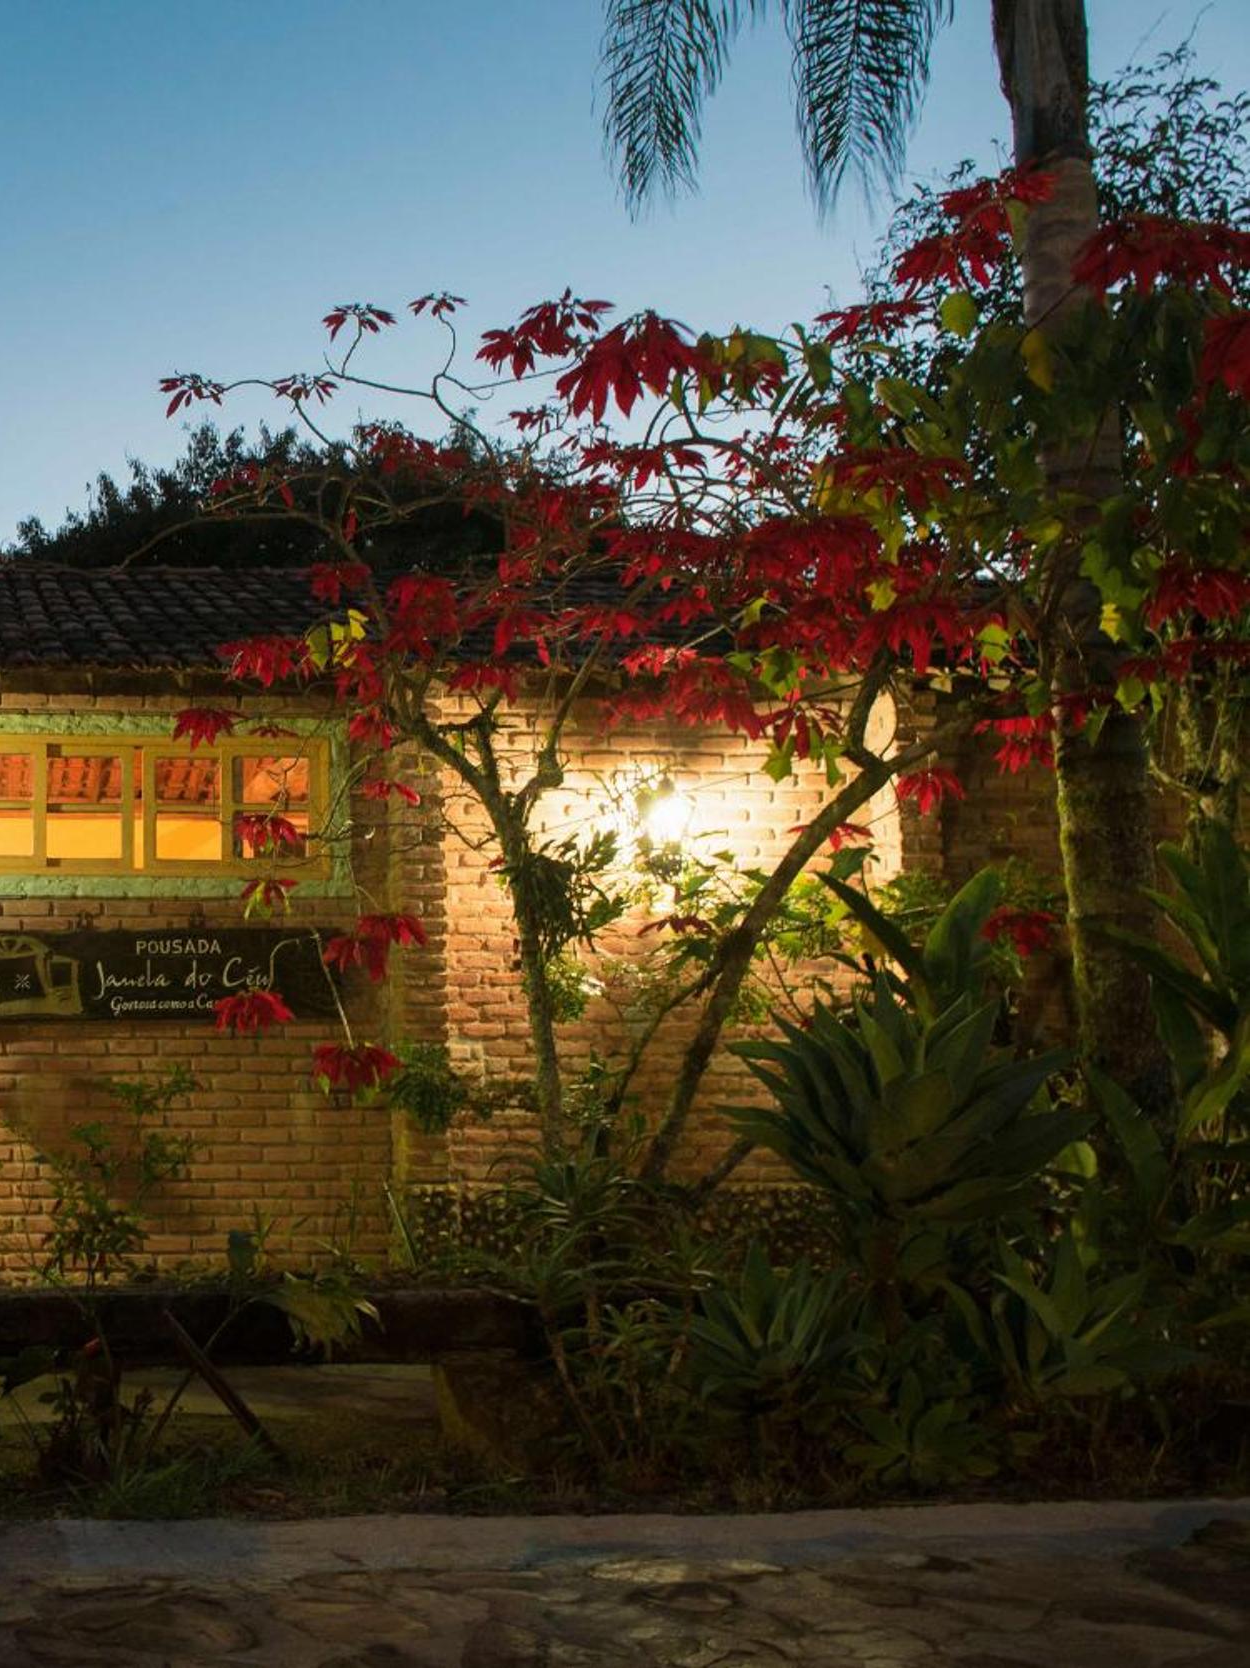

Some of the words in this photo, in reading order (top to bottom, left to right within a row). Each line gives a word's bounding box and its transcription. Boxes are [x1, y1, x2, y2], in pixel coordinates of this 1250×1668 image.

[136, 939, 222, 955] POUSADA
[95, 959, 171, 1000] Janela
[185, 959, 213, 989] do
